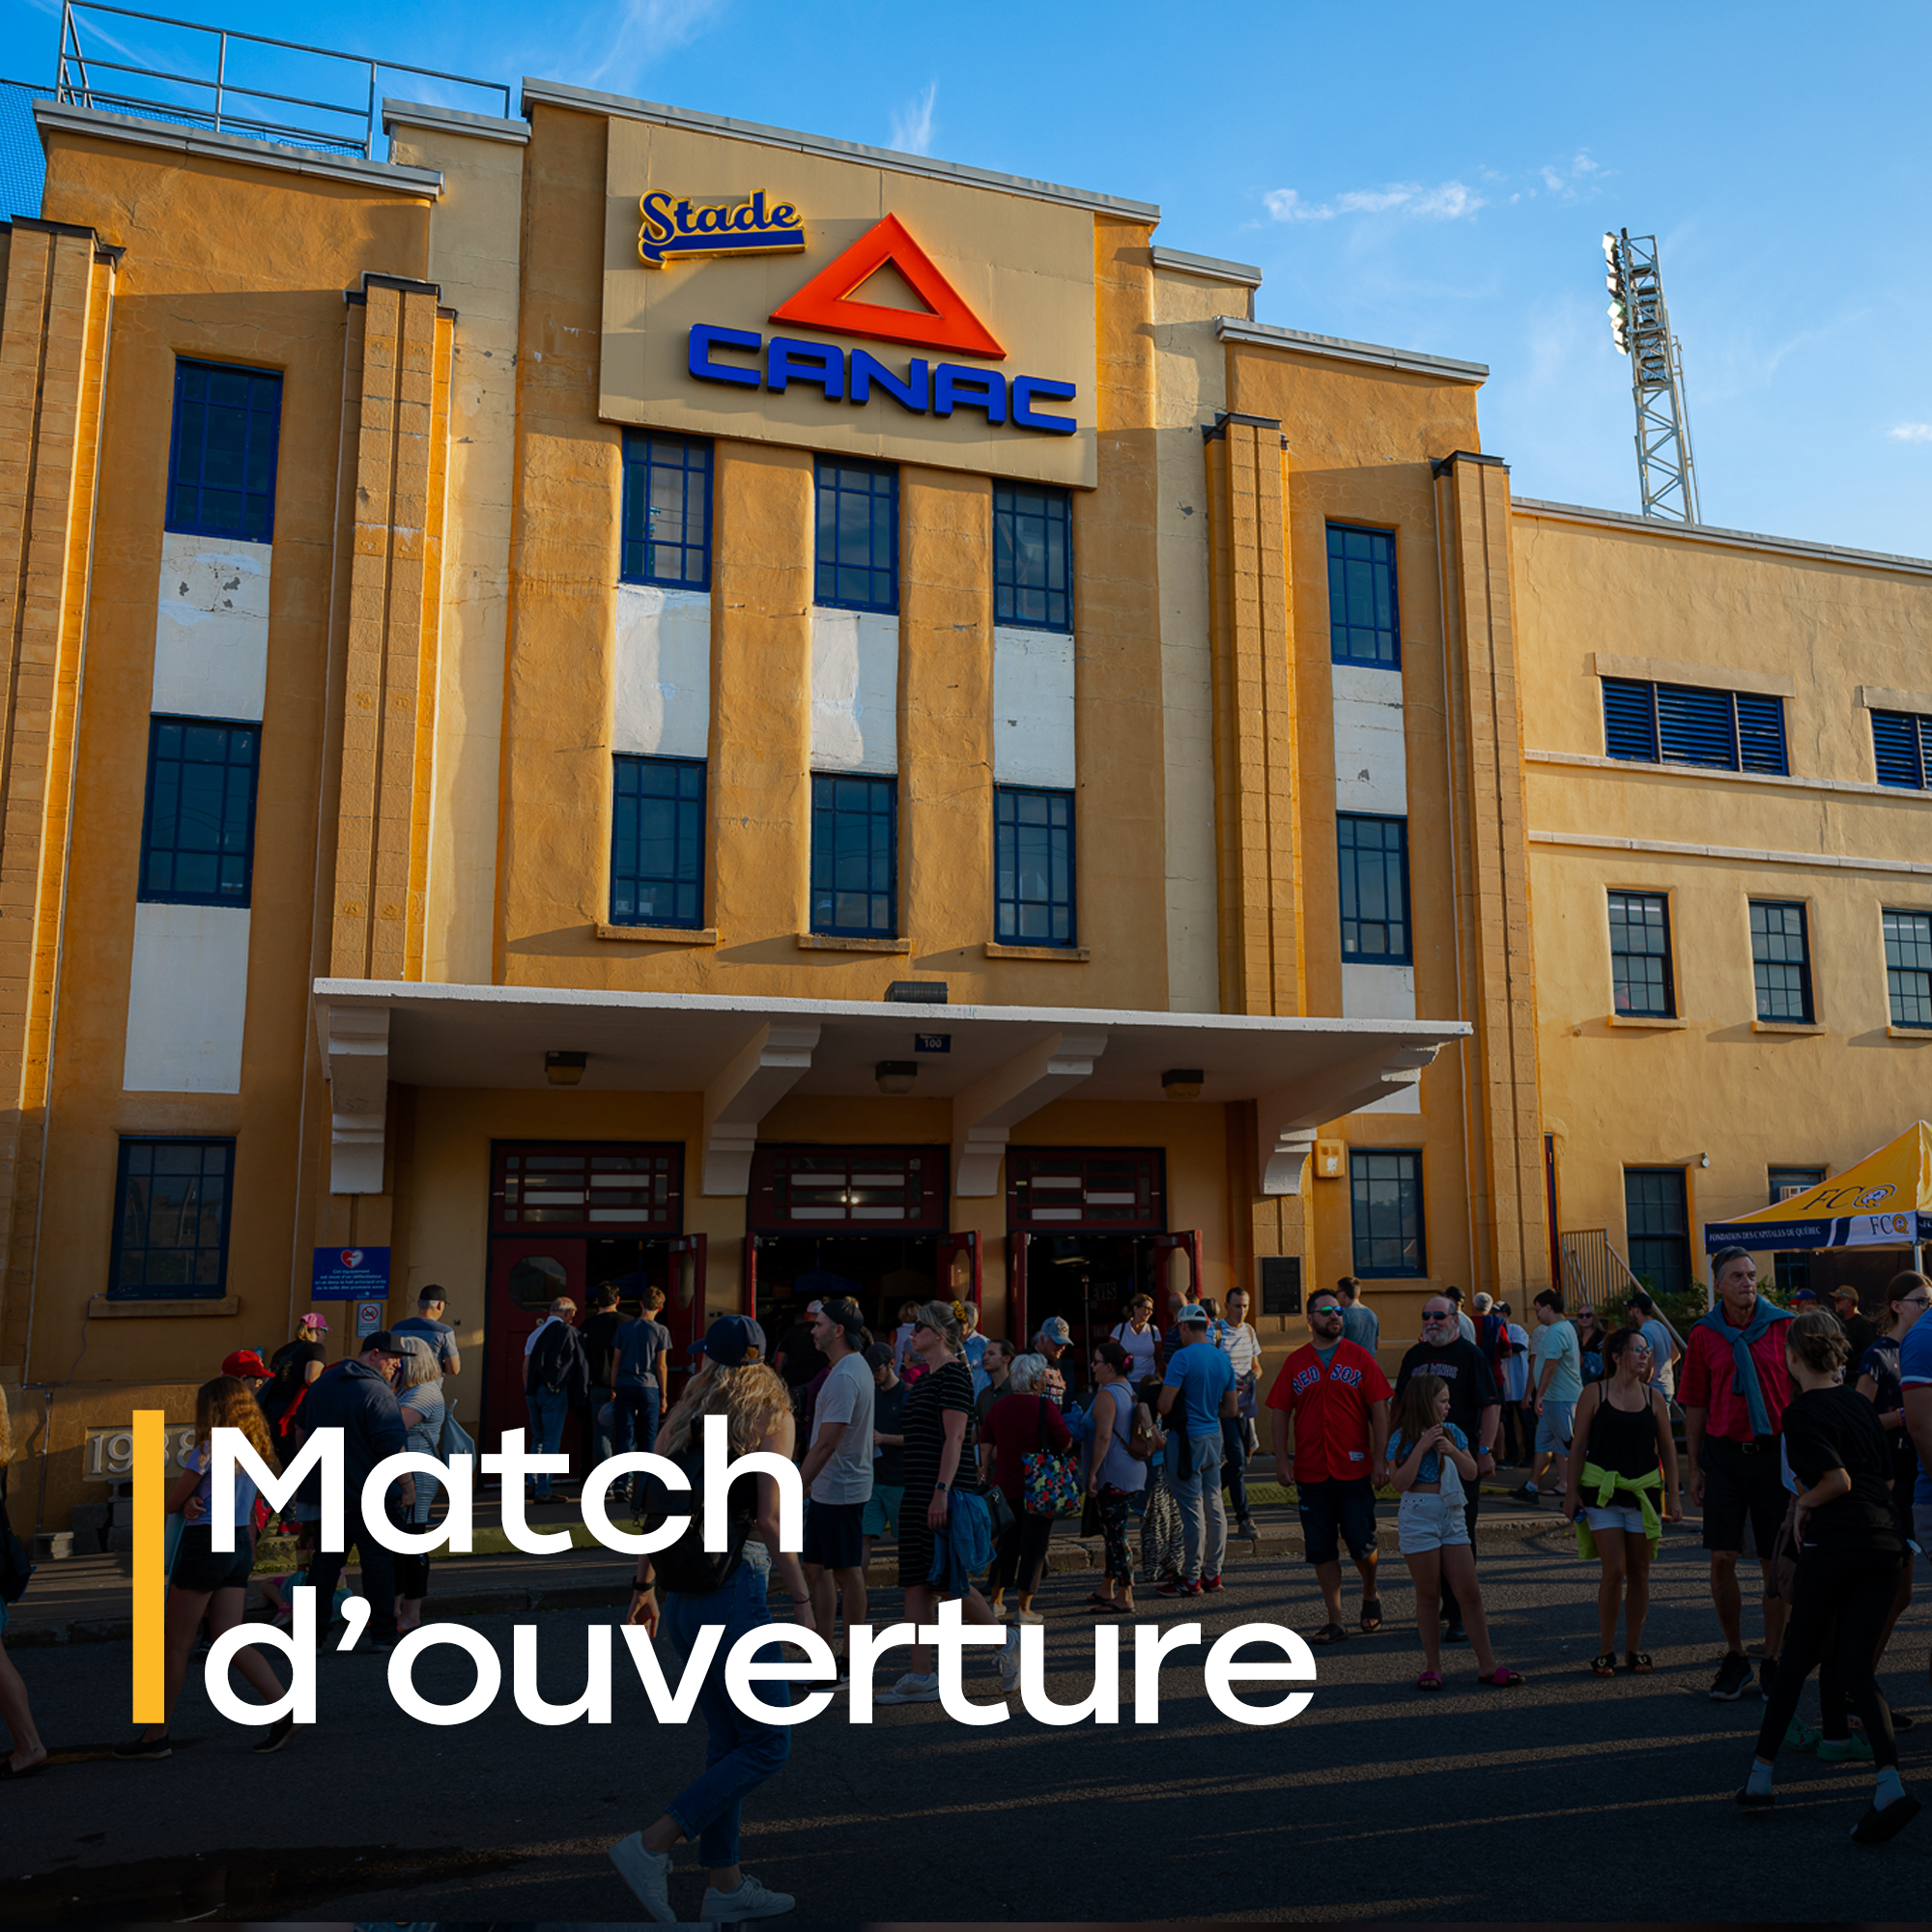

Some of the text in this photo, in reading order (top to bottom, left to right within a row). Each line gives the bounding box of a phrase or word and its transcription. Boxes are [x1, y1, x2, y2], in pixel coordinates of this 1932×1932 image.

[639, 187, 807, 247] Stade
[689, 323, 1077, 436] CANAC
[923, 1038, 942, 1048] 100
[1799, 1183, 1896, 1210] FCQ
[1709, 1233, 1742, 1242] FONDATION
[1742, 1231, 1754, 1240] DES
[1754, 1229, 1786, 1239] CAPITALES
[1786, 1228, 1795, 1236] DE
[1869, 1213, 1909, 1236] FCQ
[1292, 1363, 1363, 1396] RED SOX
